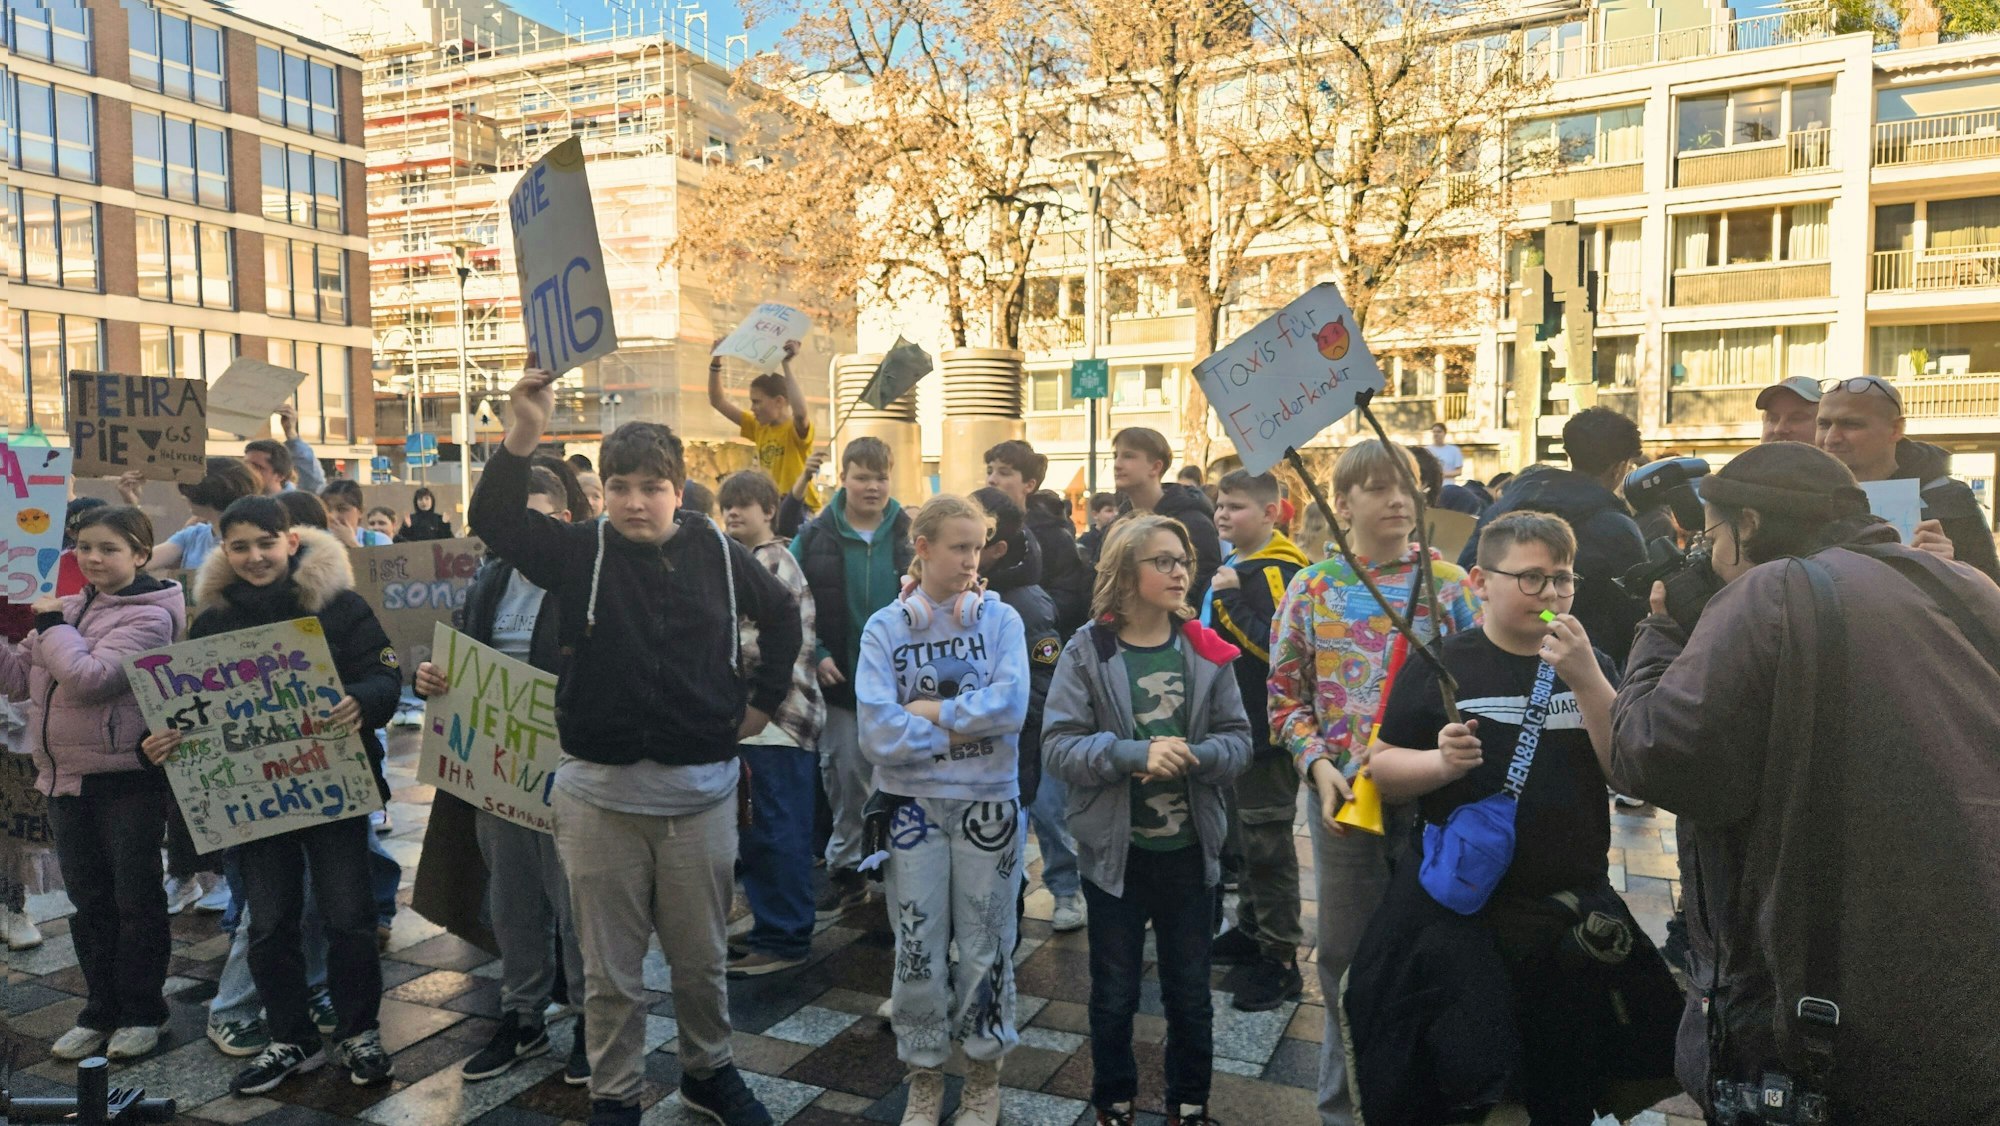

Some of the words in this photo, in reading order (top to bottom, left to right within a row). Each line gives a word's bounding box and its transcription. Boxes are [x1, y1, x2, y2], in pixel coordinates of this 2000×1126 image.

[1205, 341, 1276, 395] Taxis
[1277, 309, 1316, 348] für
[70, 374, 205, 418] TEHRA
[1229, 367, 1350, 452] Förderkinder
[369, 555, 409, 582] ist
[893, 633, 987, 672] STITCH
[166, 695, 211, 731] ist
[200, 757, 236, 789] ist
[262, 740, 330, 781] nicht
[438, 755, 475, 790] IHR
